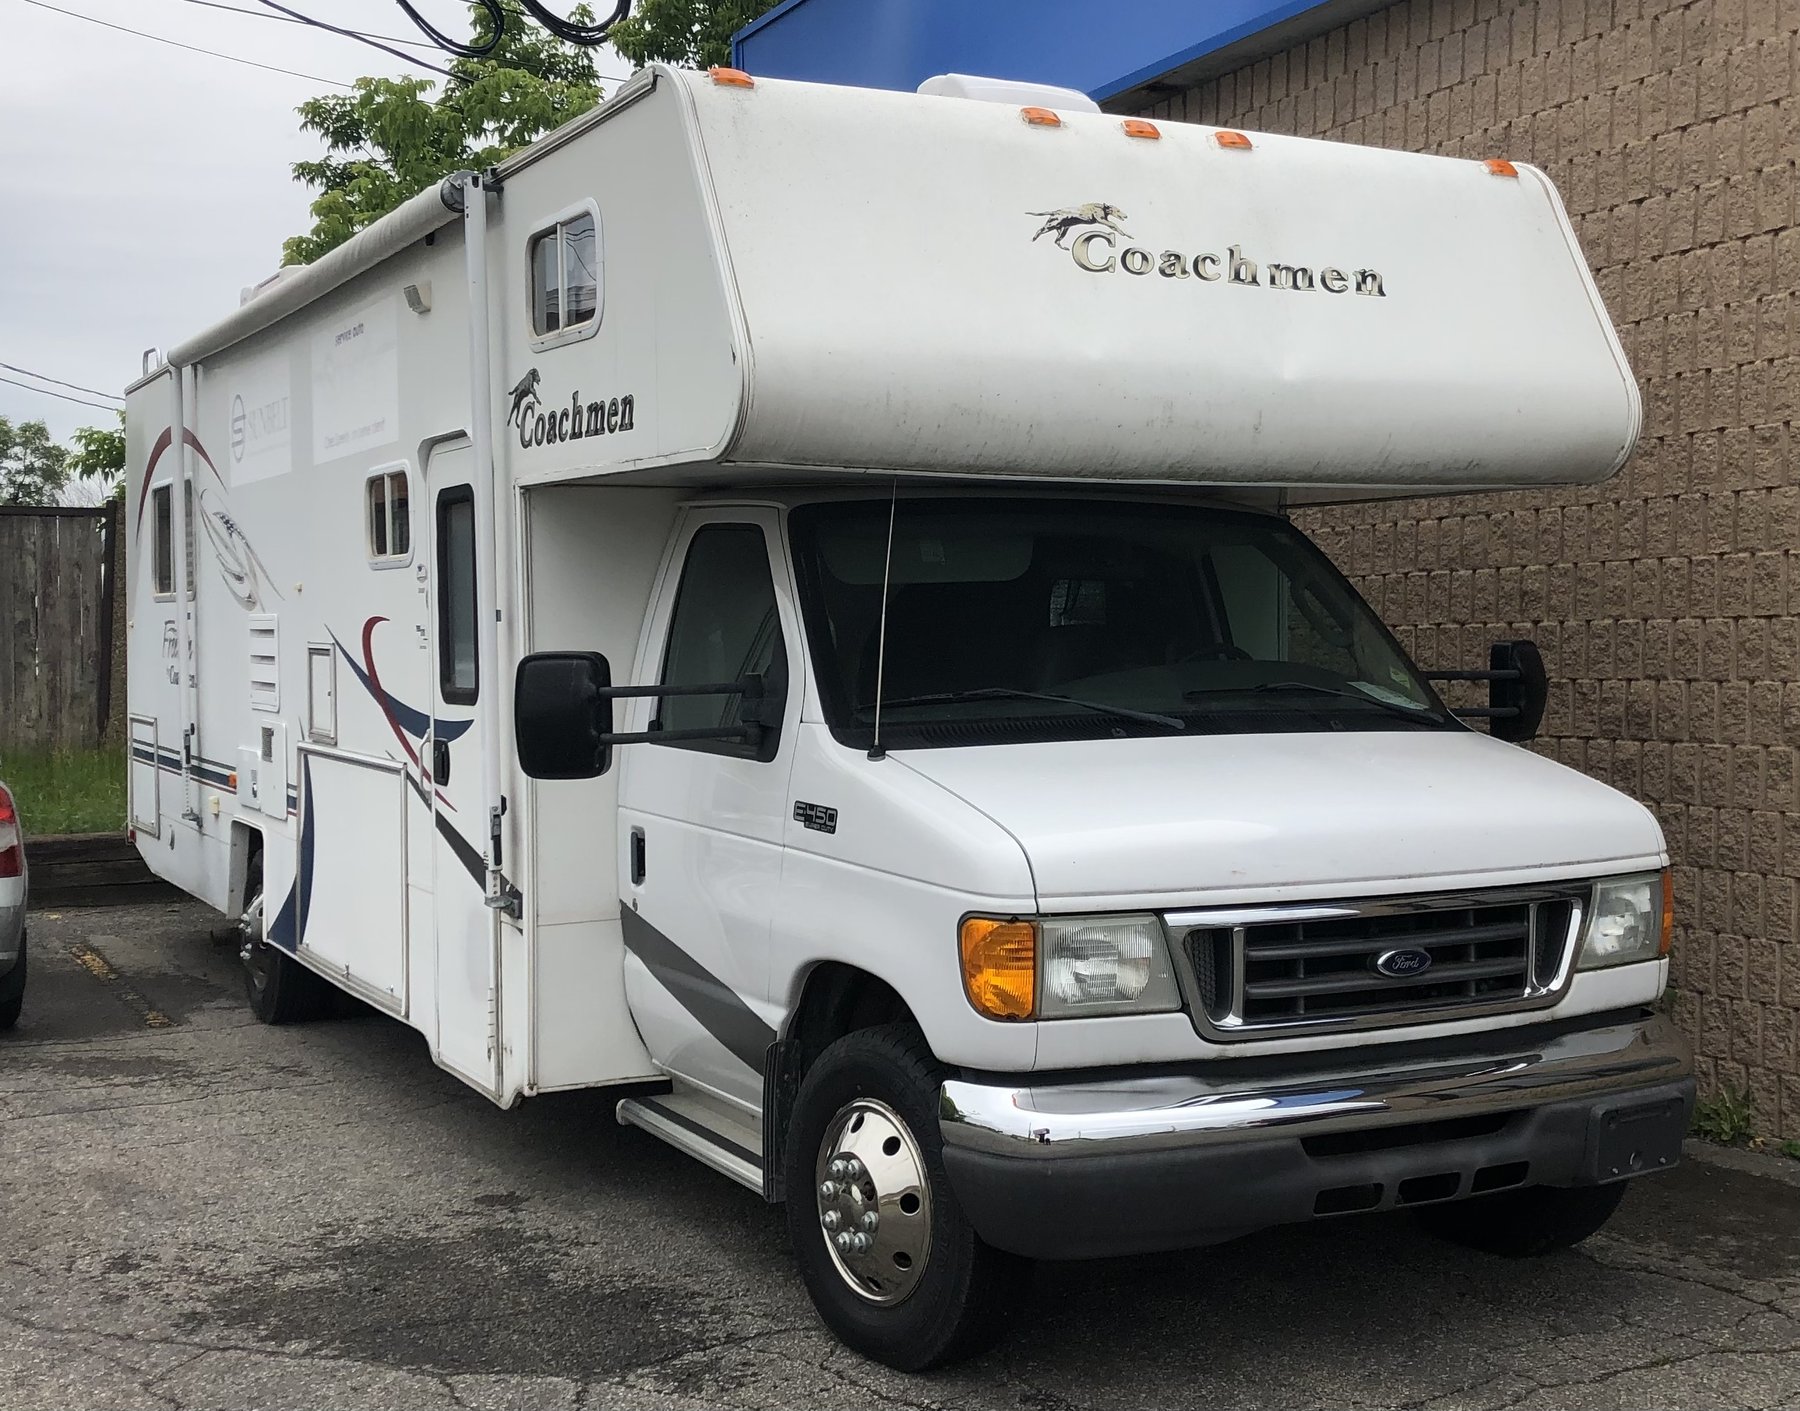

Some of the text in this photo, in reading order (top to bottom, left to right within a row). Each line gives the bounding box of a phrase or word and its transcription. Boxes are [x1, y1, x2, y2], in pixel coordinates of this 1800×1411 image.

[1071, 230, 1387, 298] Coachmen
[520, 390, 635, 449] Coachmen
[1392, 954, 1420, 970] Ford
